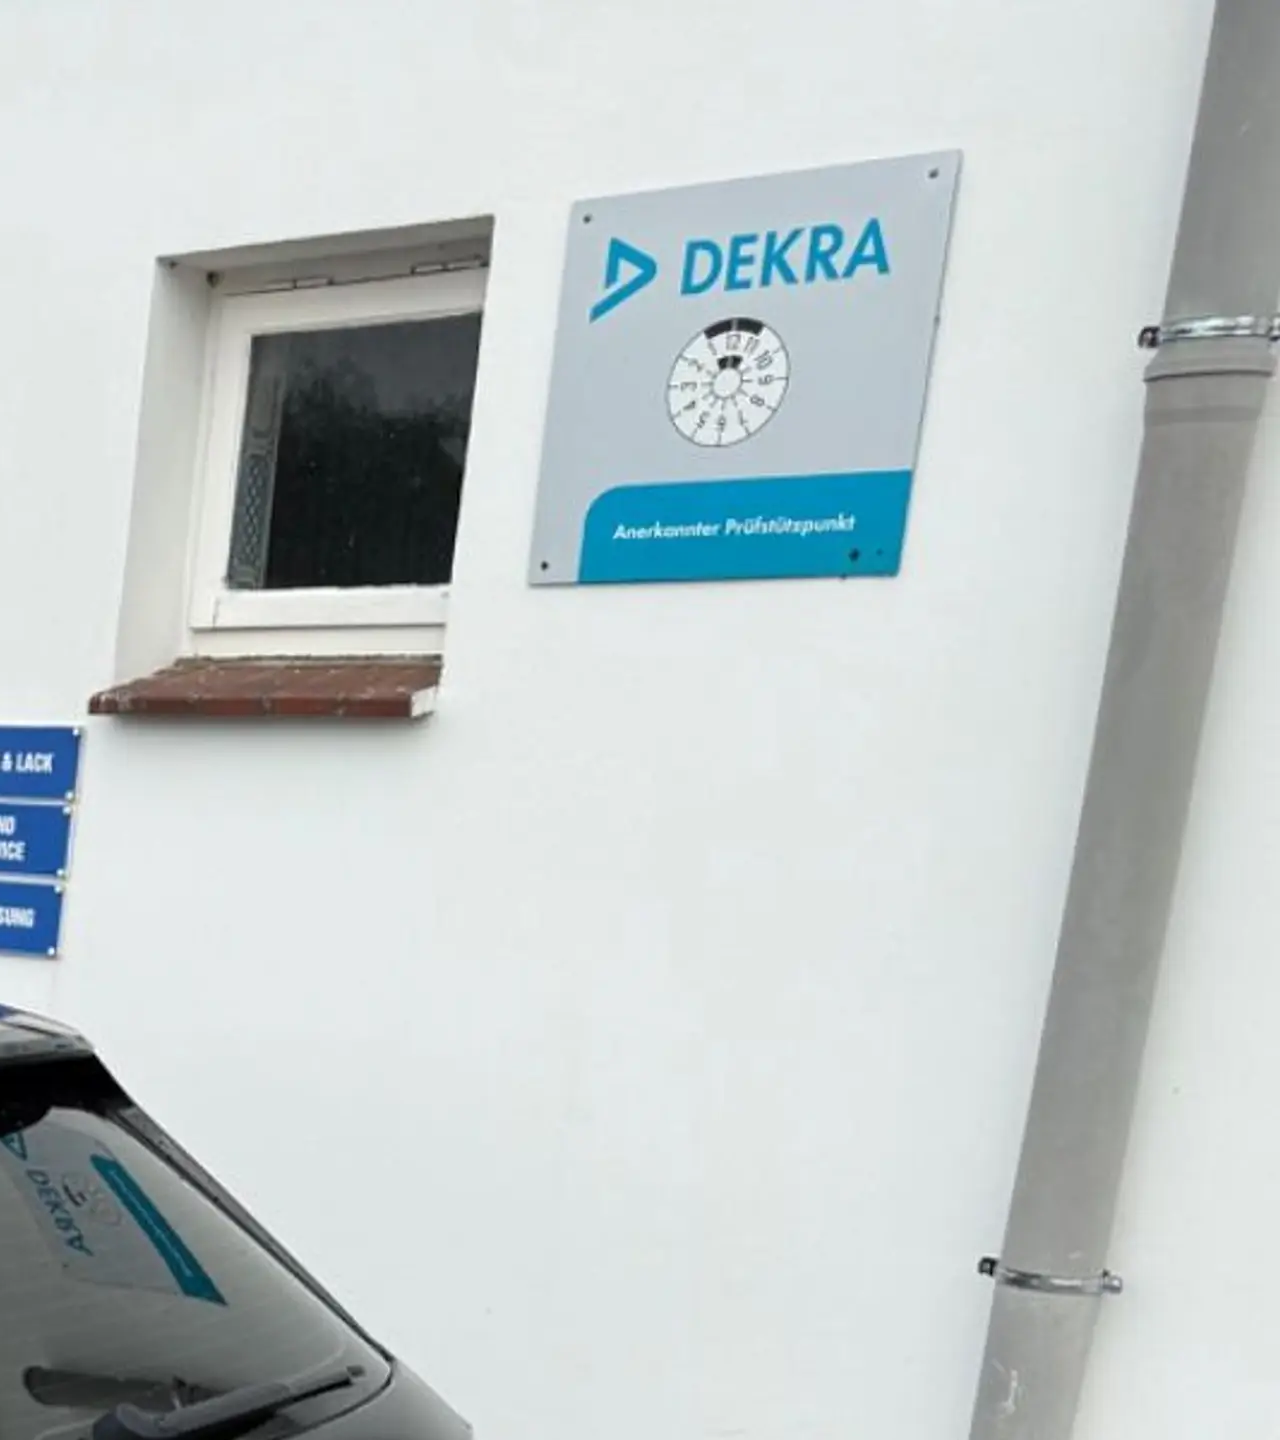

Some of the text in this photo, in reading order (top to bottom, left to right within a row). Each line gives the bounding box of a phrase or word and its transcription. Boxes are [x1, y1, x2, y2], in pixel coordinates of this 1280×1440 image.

[680, 218, 890, 295] DEKRA
[612, 513, 856, 540] Anerkannter Prüfstützpunkt
[1, 752, 13, 772] &
[16, 751, 54, 773] LACK
